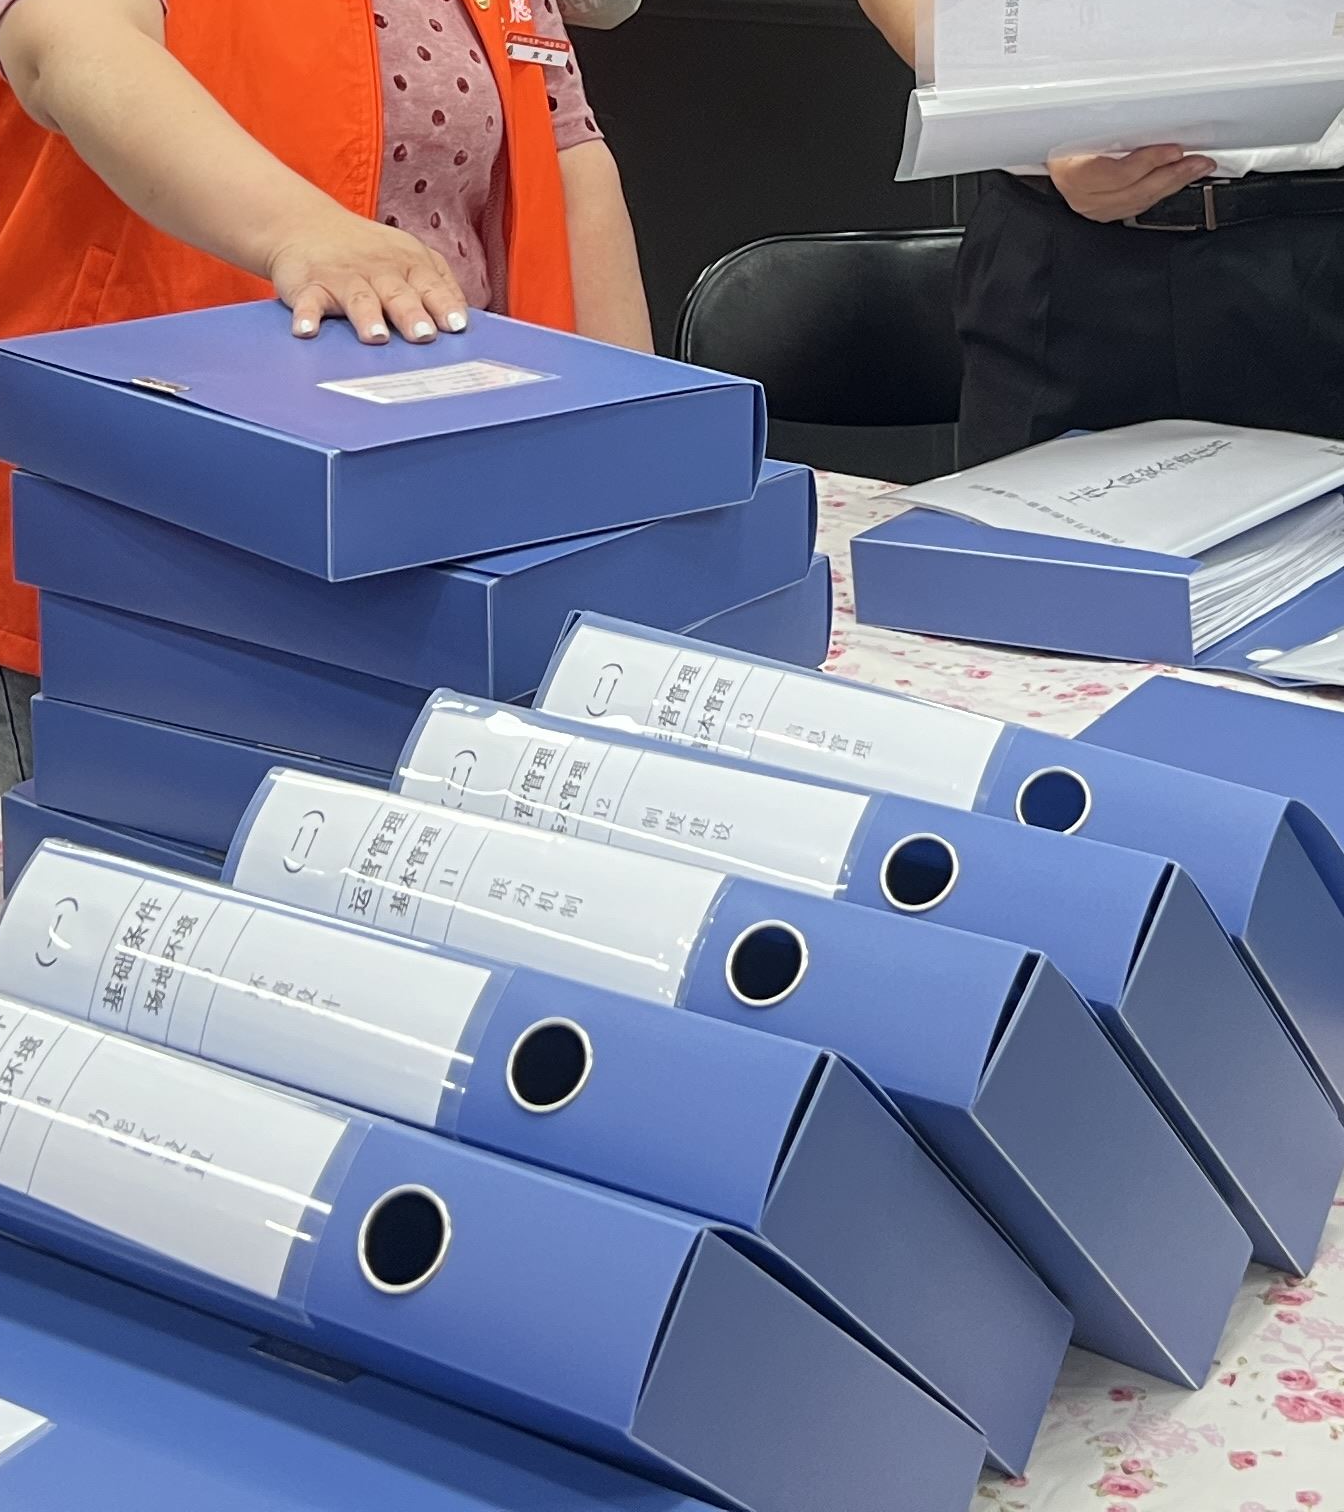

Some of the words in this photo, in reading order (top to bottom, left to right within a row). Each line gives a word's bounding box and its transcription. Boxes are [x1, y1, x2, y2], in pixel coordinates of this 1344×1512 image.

[588, 797, 612, 821] 12
[640, 806, 734, 841] 制度建设
[346, 805, 410, 919] 运营管理
[389, 825, 443, 918] 基本管理
[487, 877, 584, 919] 联动机制
[90, 897, 163, 1014] 基础条件
[142, 911, 200, 1017] 场地环境
